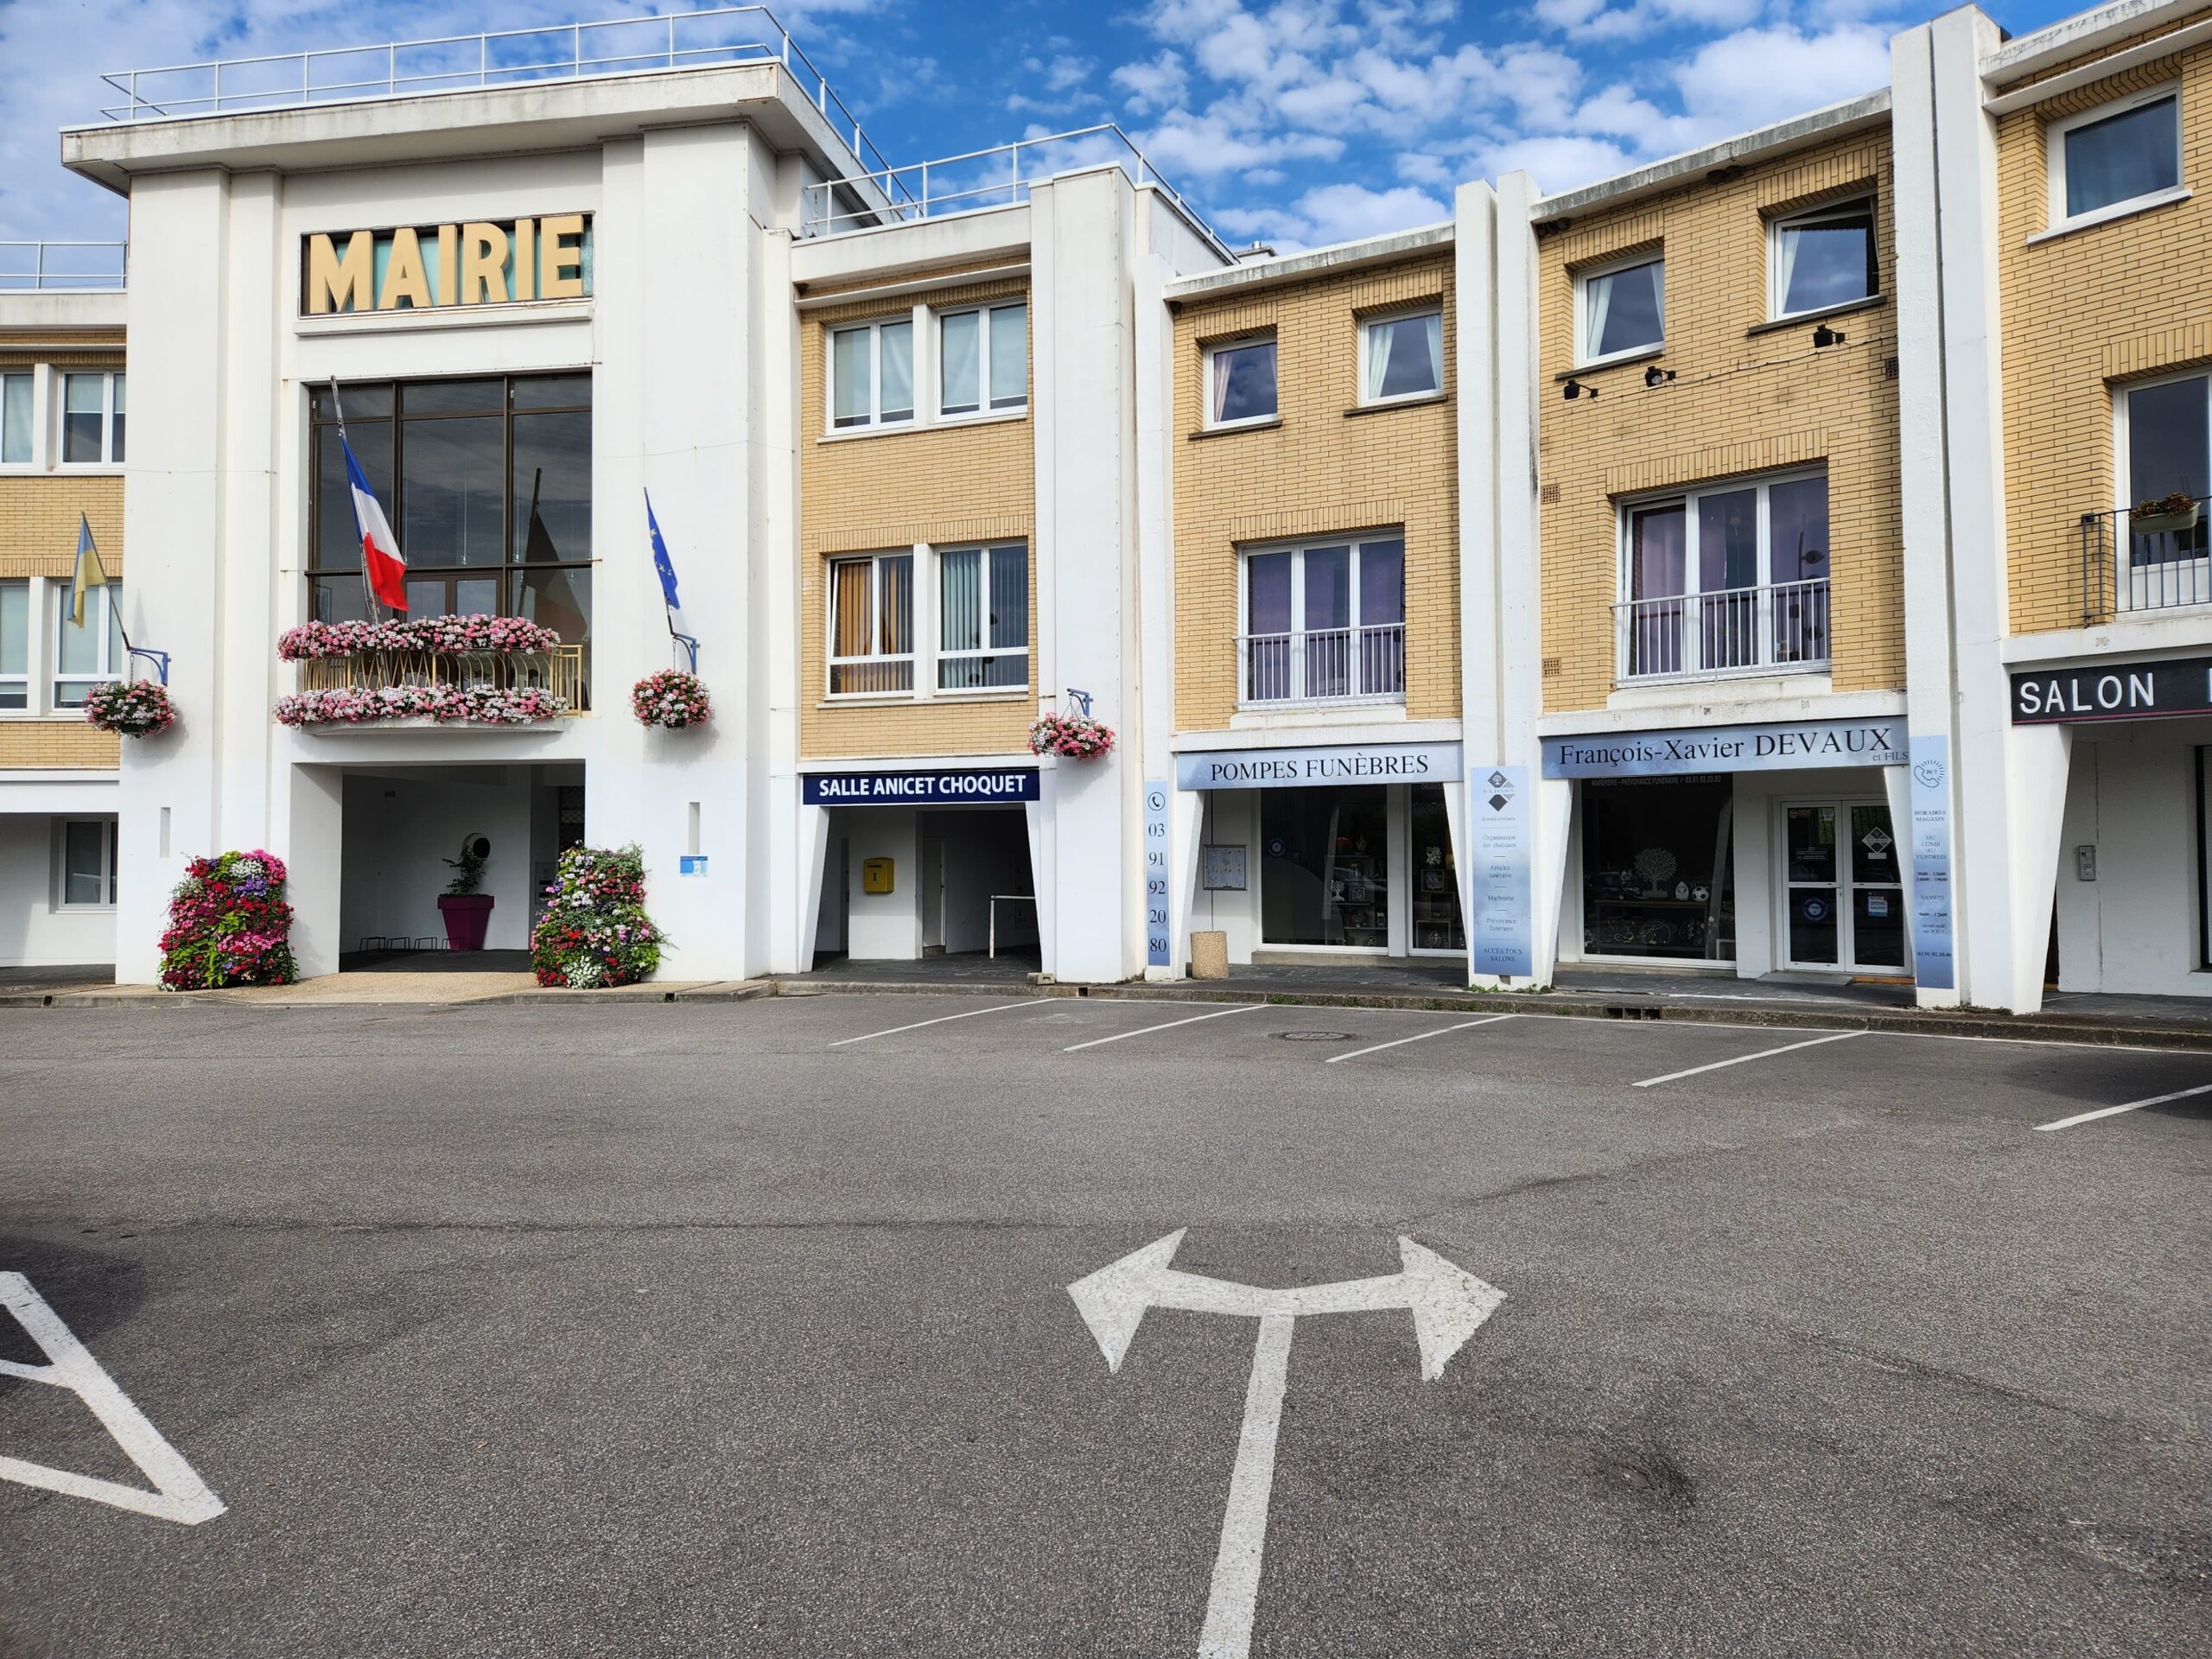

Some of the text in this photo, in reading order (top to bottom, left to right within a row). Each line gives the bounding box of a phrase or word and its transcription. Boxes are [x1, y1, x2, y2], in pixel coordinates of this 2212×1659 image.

[309, 214, 584, 315] MAIRIE
[2018, 672, 2155, 715] SALON
[1559, 728, 1892, 767] François-Xavier DEVAUX
[1872, 751, 1909, 762] et FILS
[1210, 752, 1429, 781] POMPES FUNÈBRES
[819, 774, 1027, 797] SALLE ANICET CHOQUET
[1685, 774, 1721, 784] 03.91.92.20.80
[1147, 823, 1165, 838] 03
[1148, 851, 1165, 866] 91
[1148, 880, 1166, 895] 92
[1149, 909, 1166, 924] 20
[1150, 938, 1166, 952] 80
